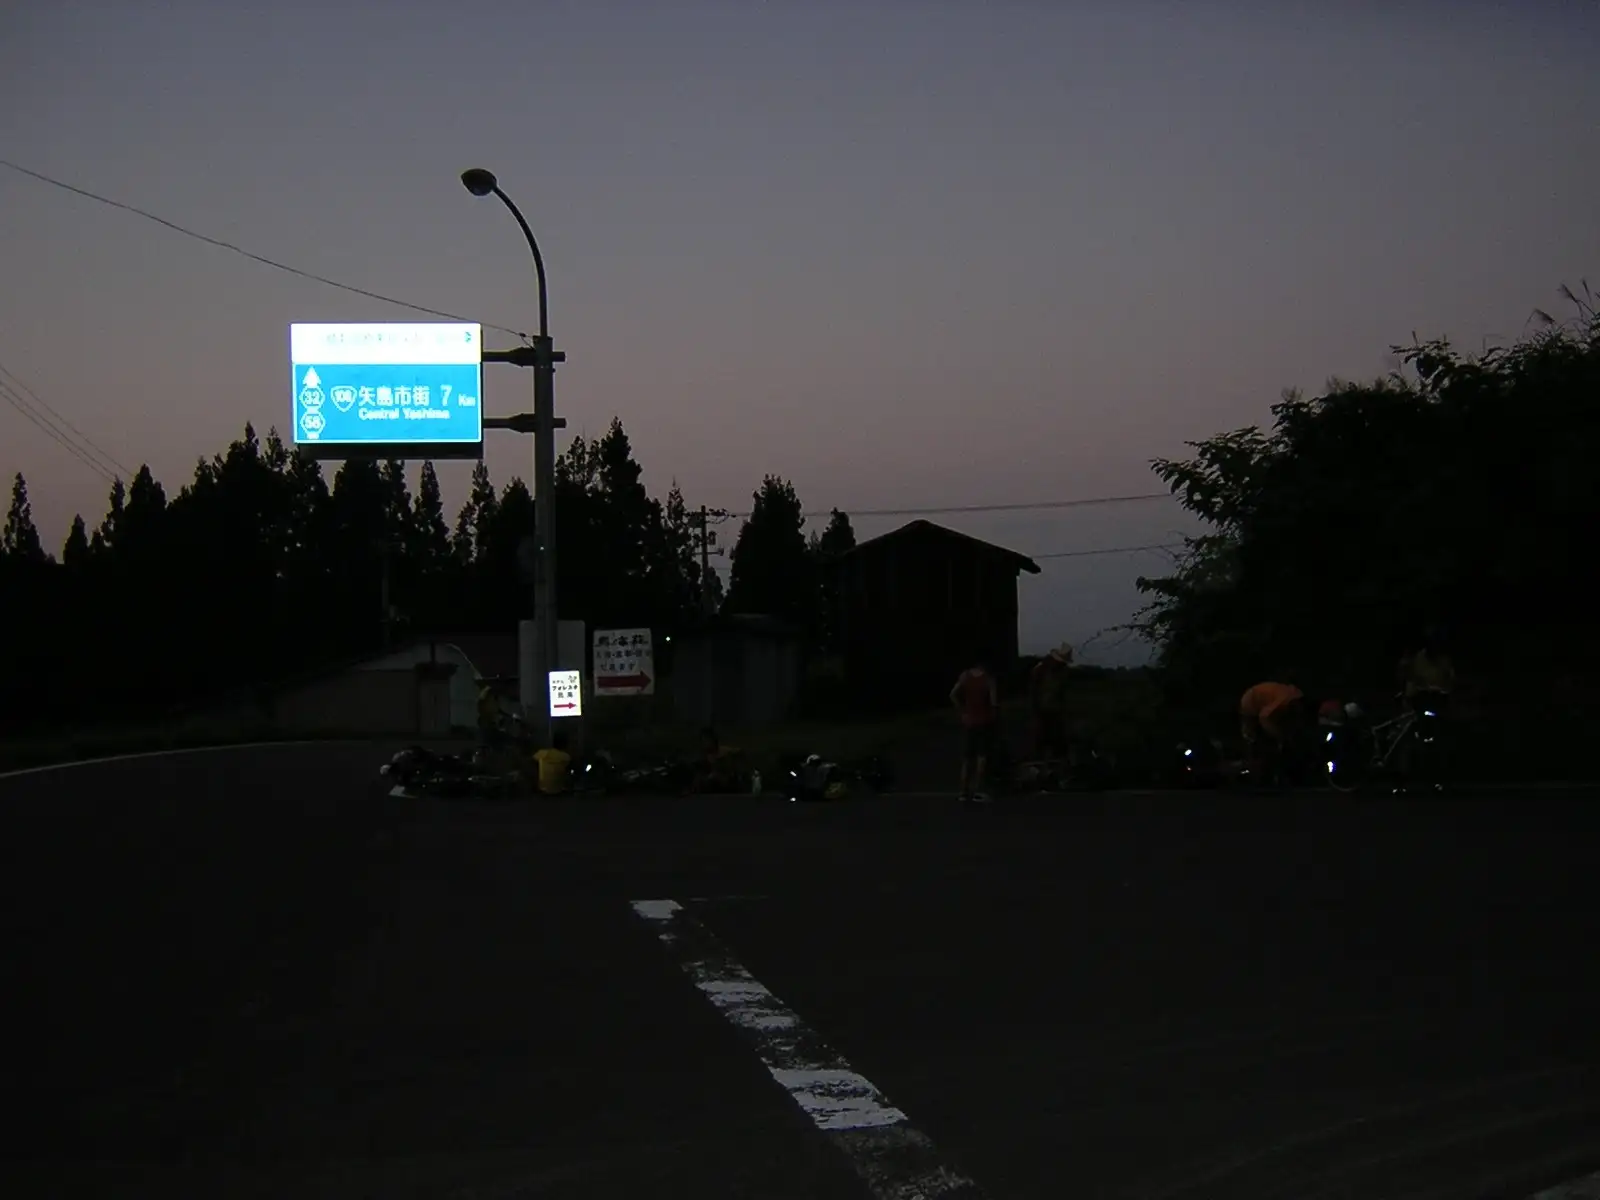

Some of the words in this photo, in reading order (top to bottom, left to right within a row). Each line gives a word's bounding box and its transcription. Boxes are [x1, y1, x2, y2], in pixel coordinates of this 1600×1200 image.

[305, 390, 321, 405] 32
[358, 385, 430, 406] 矢島市街
[440, 384, 453, 407] 7
[358, 408, 400, 421] Central
[402, 408, 450, 420] Yashima
